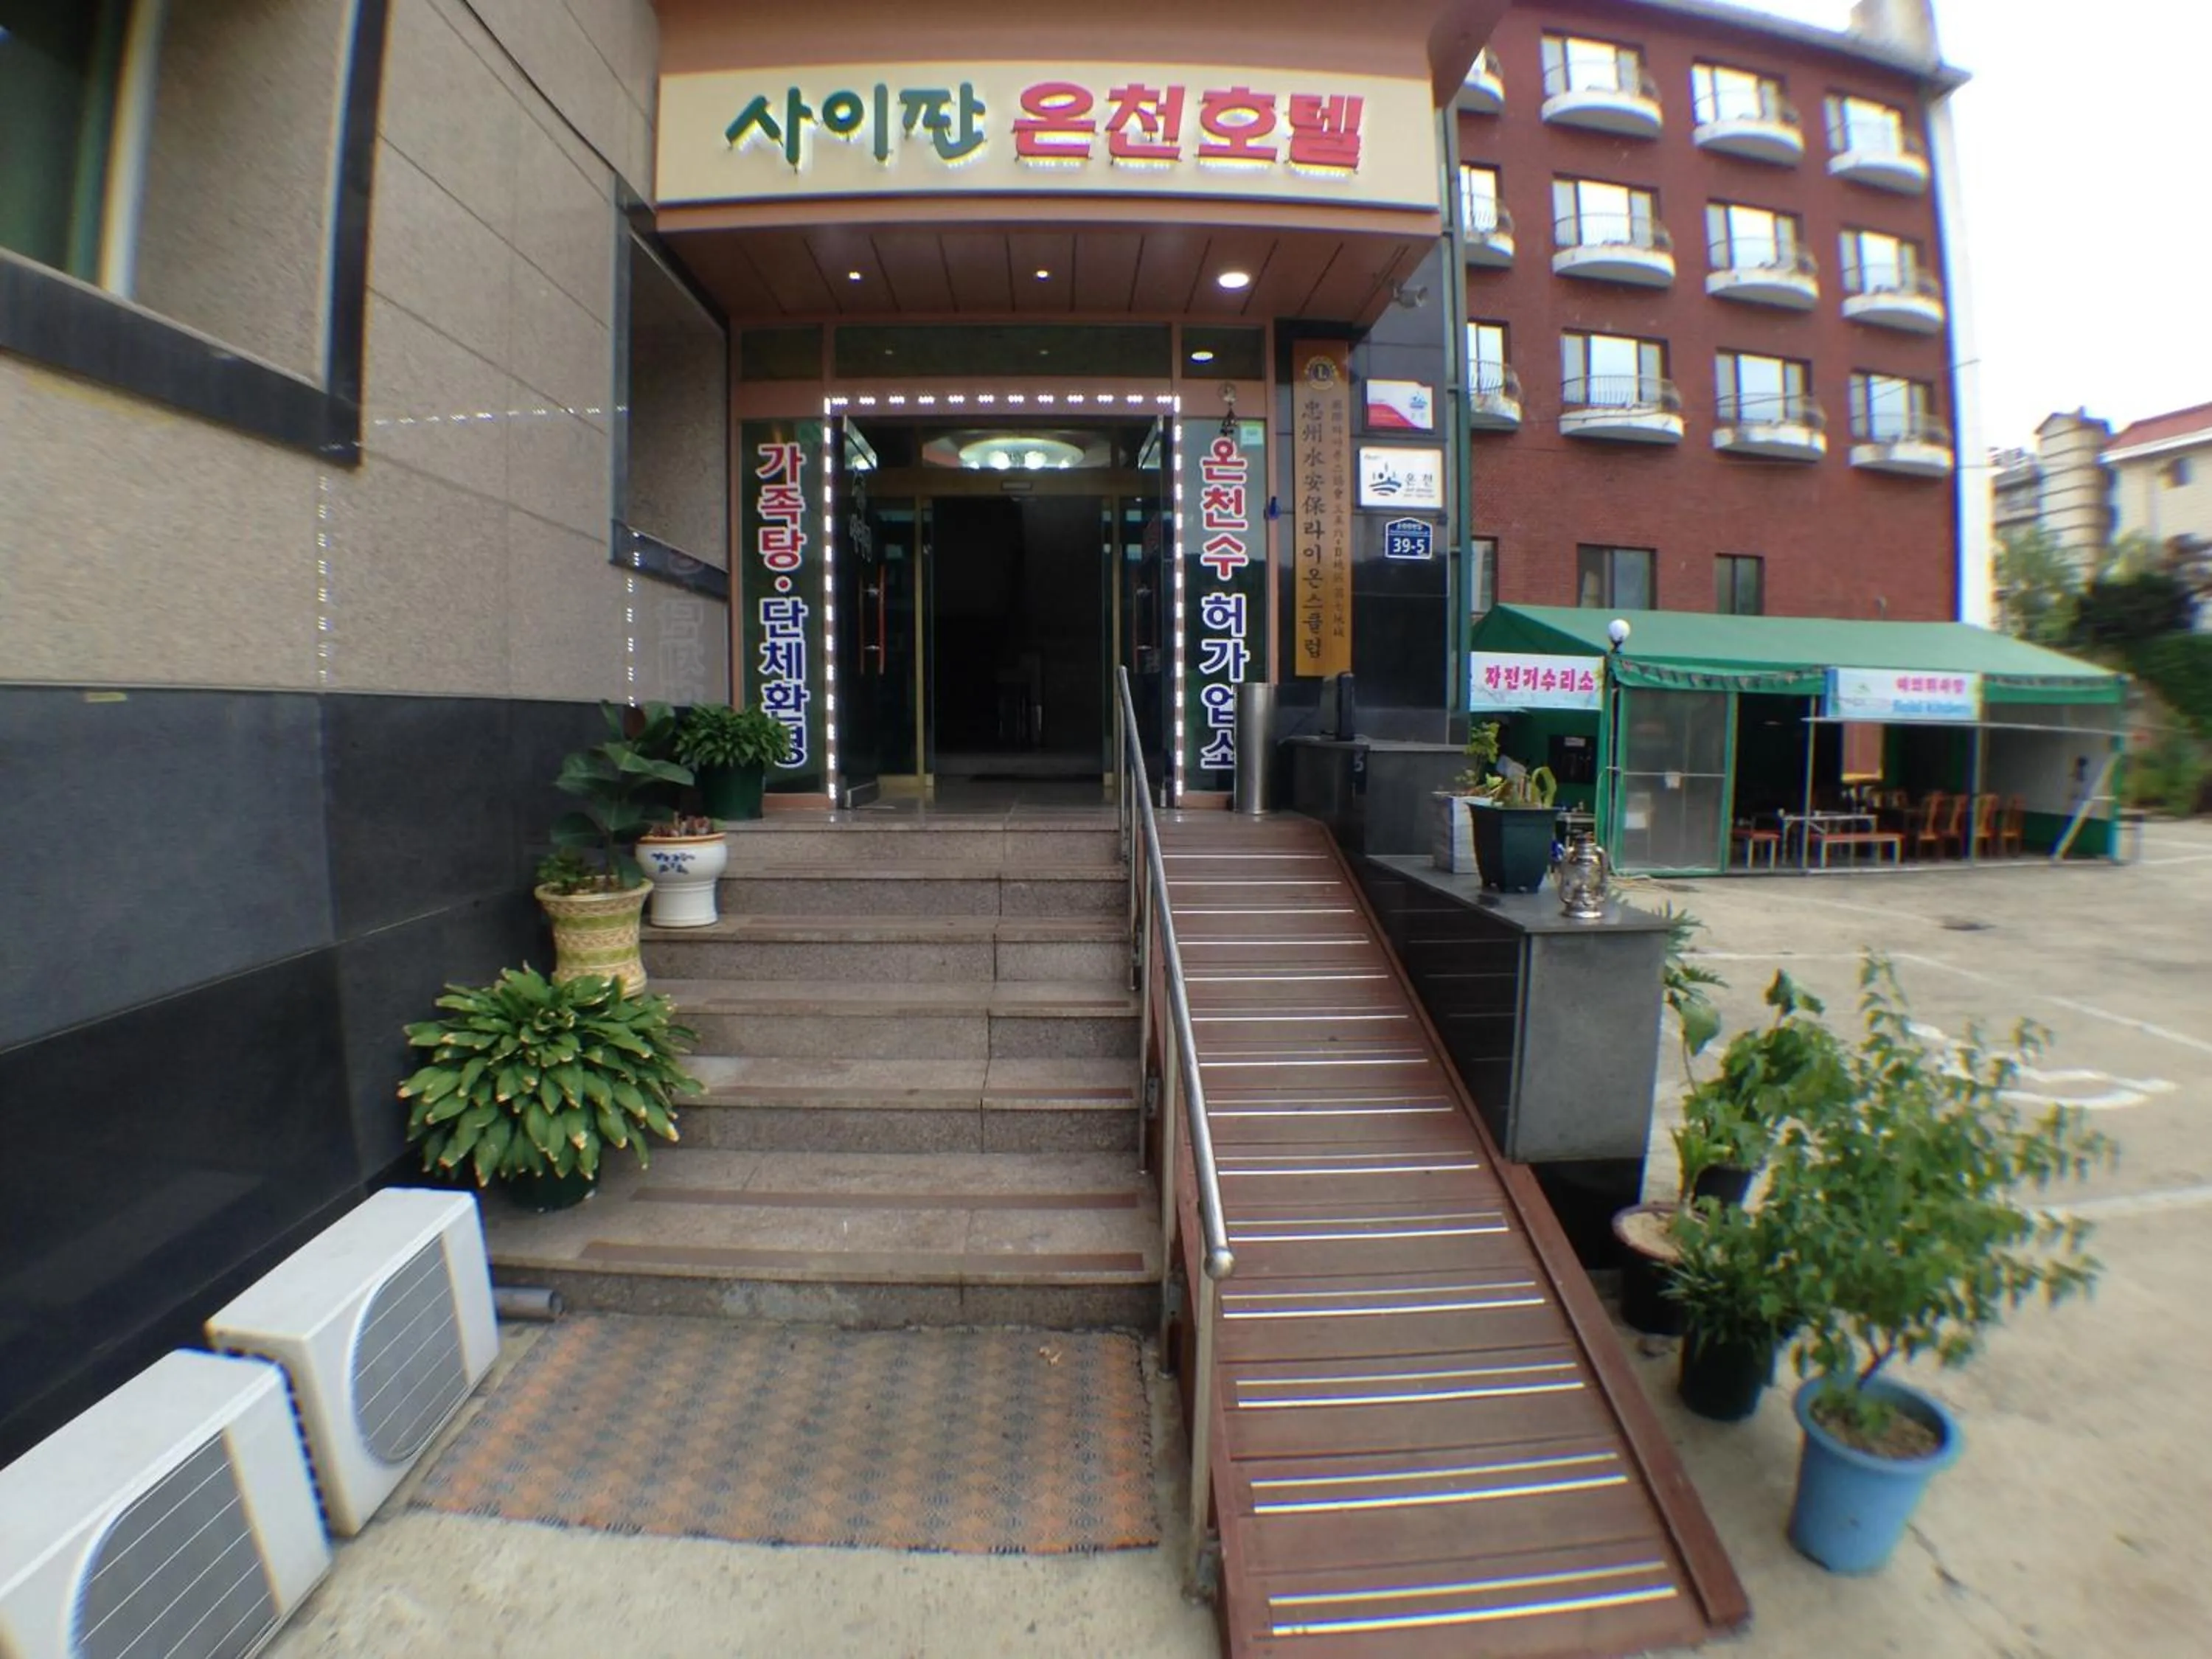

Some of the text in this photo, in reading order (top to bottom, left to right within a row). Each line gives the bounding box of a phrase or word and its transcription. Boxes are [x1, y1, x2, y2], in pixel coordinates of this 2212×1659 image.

[725, 81, 1364, 168] 사이판 온천호텔
[1200, 437, 1248, 580] 온천수
[1393, 538, 1425, 554] 39-5
